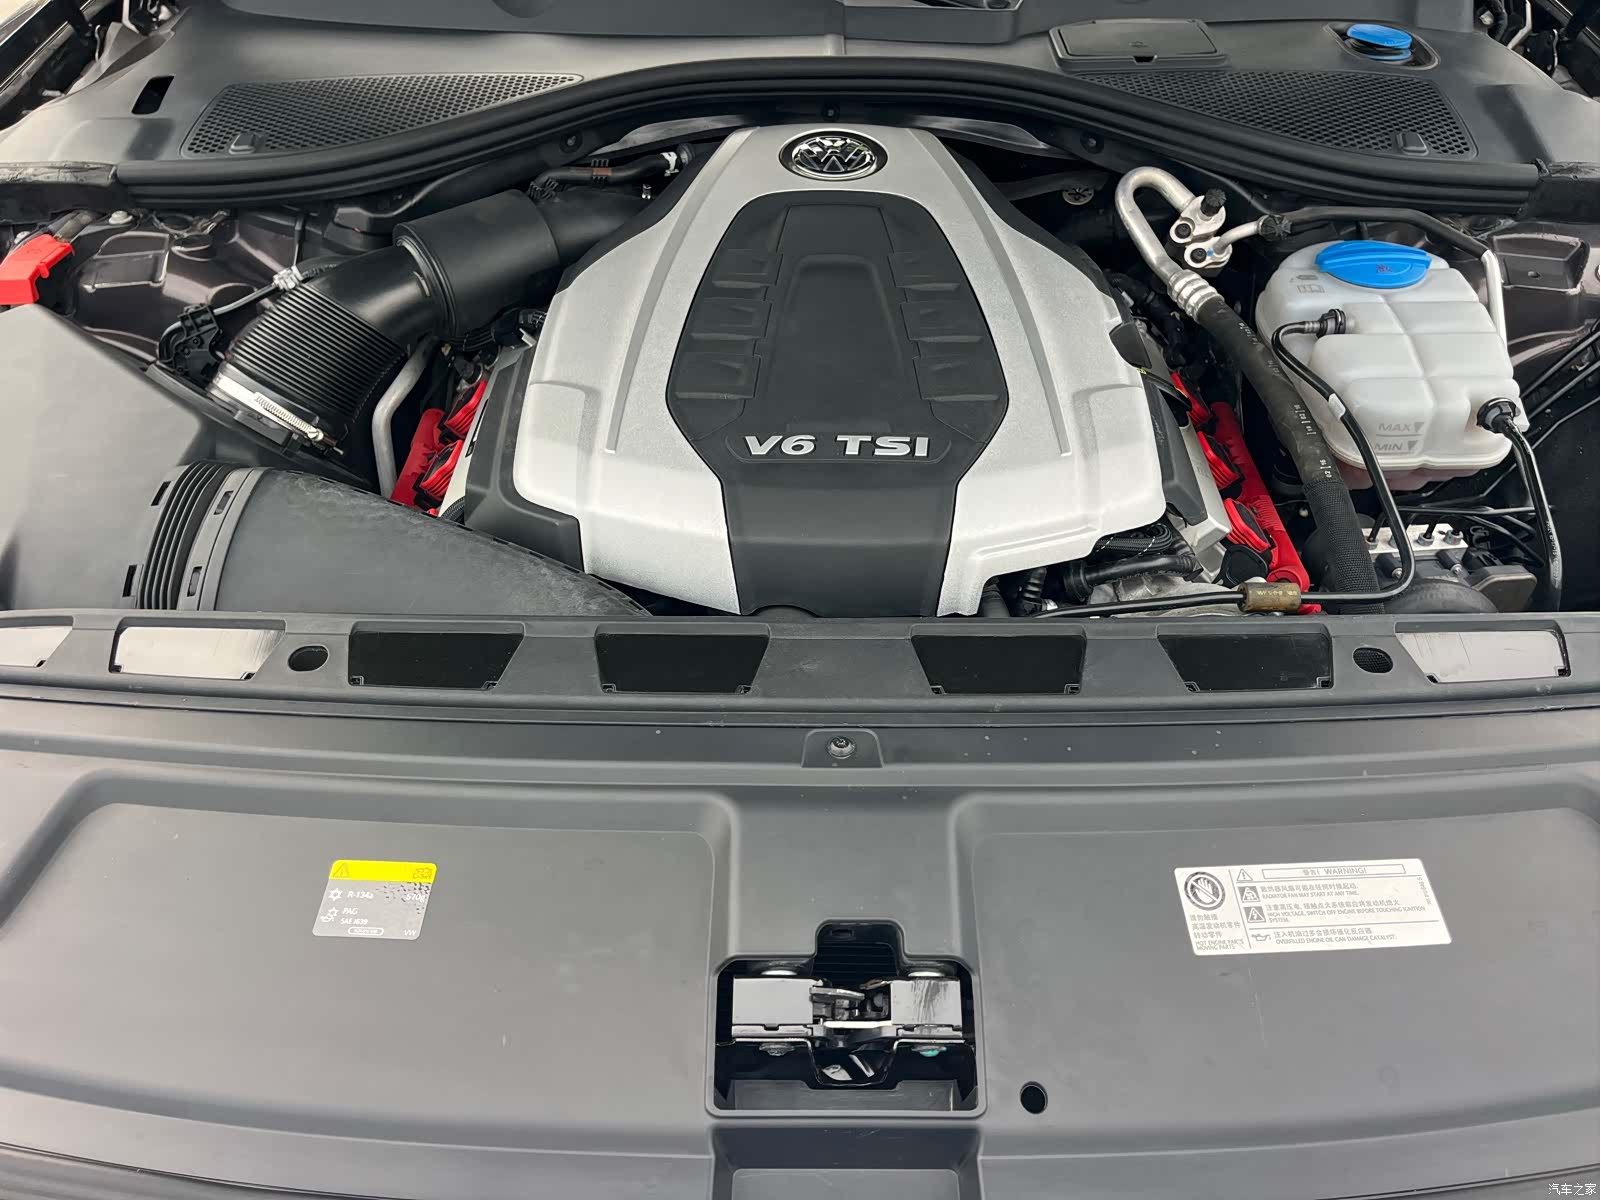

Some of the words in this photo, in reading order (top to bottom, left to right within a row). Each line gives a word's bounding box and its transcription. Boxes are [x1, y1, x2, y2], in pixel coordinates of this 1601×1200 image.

[1378, 422, 1412, 432] MAX
[744, 434, 816, 456] V6
[836, 434, 929, 457] TSI
[1374, 442, 1403, 451] MIN
[1324, 867, 1367, 875] WARNING!
[346, 890, 374, 900] R-134a
[405, 893, 425, 903] 570g
[341, 907, 359, 915] PAG
[340, 917, 352, 925] SAE
